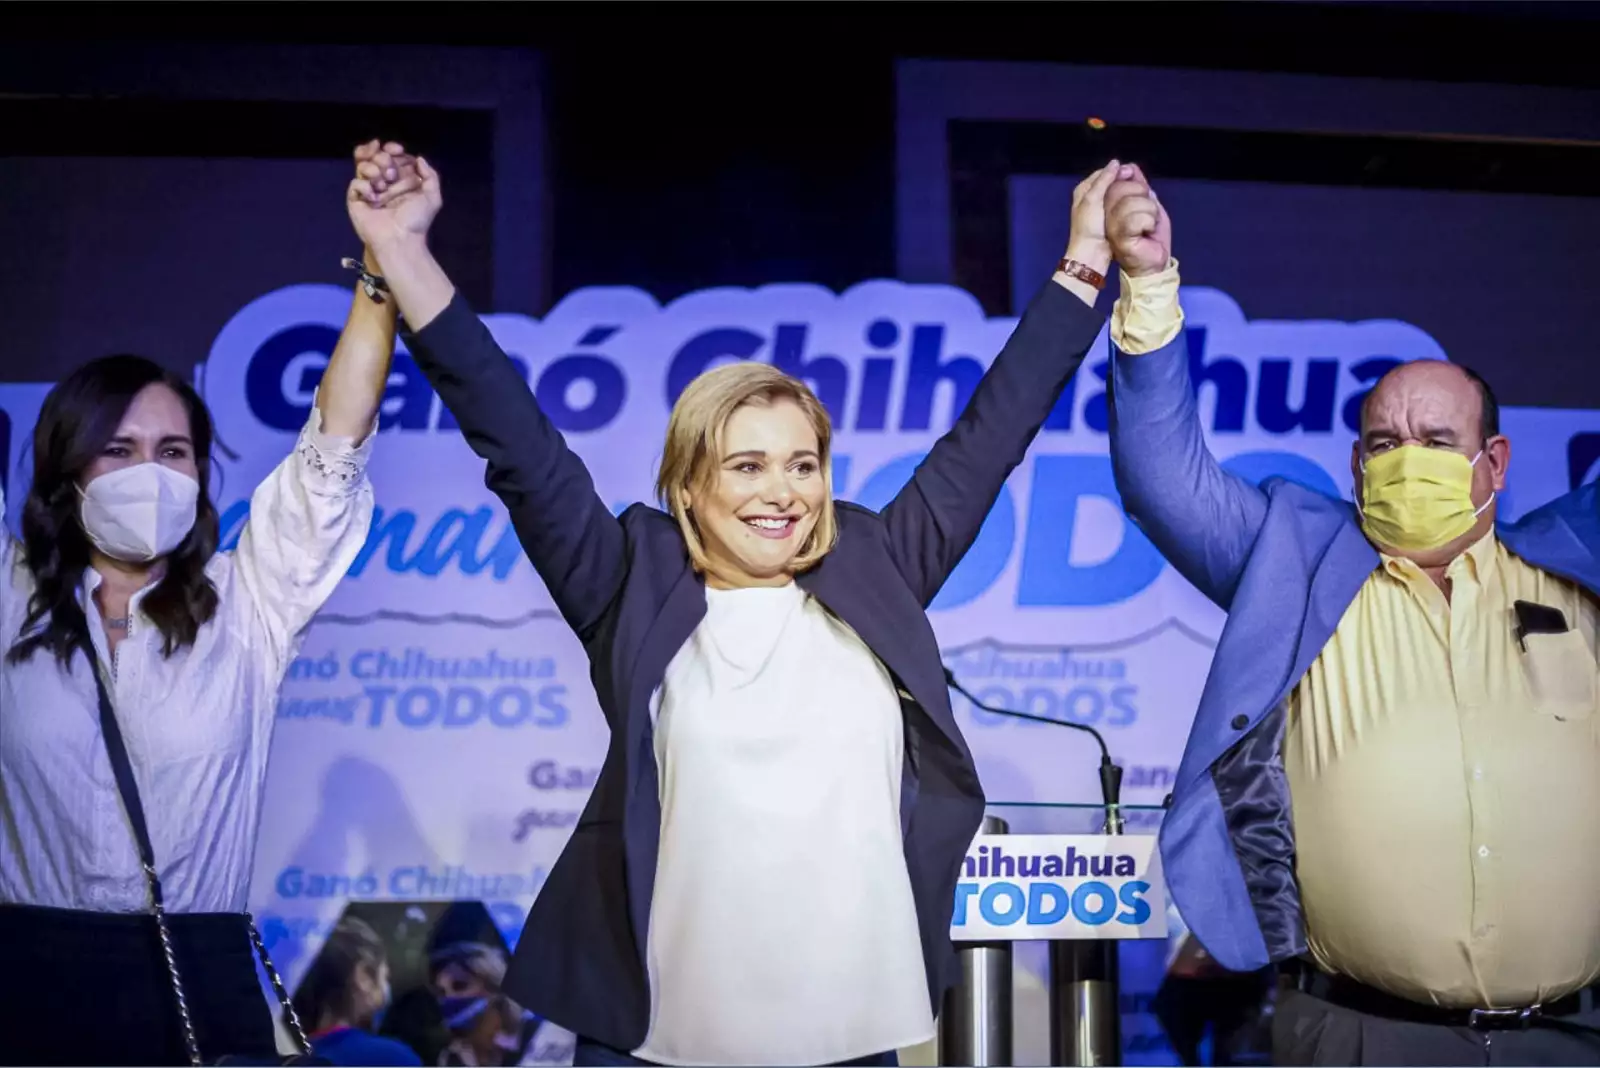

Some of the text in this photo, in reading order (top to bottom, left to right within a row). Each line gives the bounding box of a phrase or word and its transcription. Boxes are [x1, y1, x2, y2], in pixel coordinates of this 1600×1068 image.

[349, 648, 556, 680] Chihuahua
[362, 685, 569, 730] TODOS
[971, 684, 1139, 727] ODOS
[952, 881, 1151, 925] TODOS
